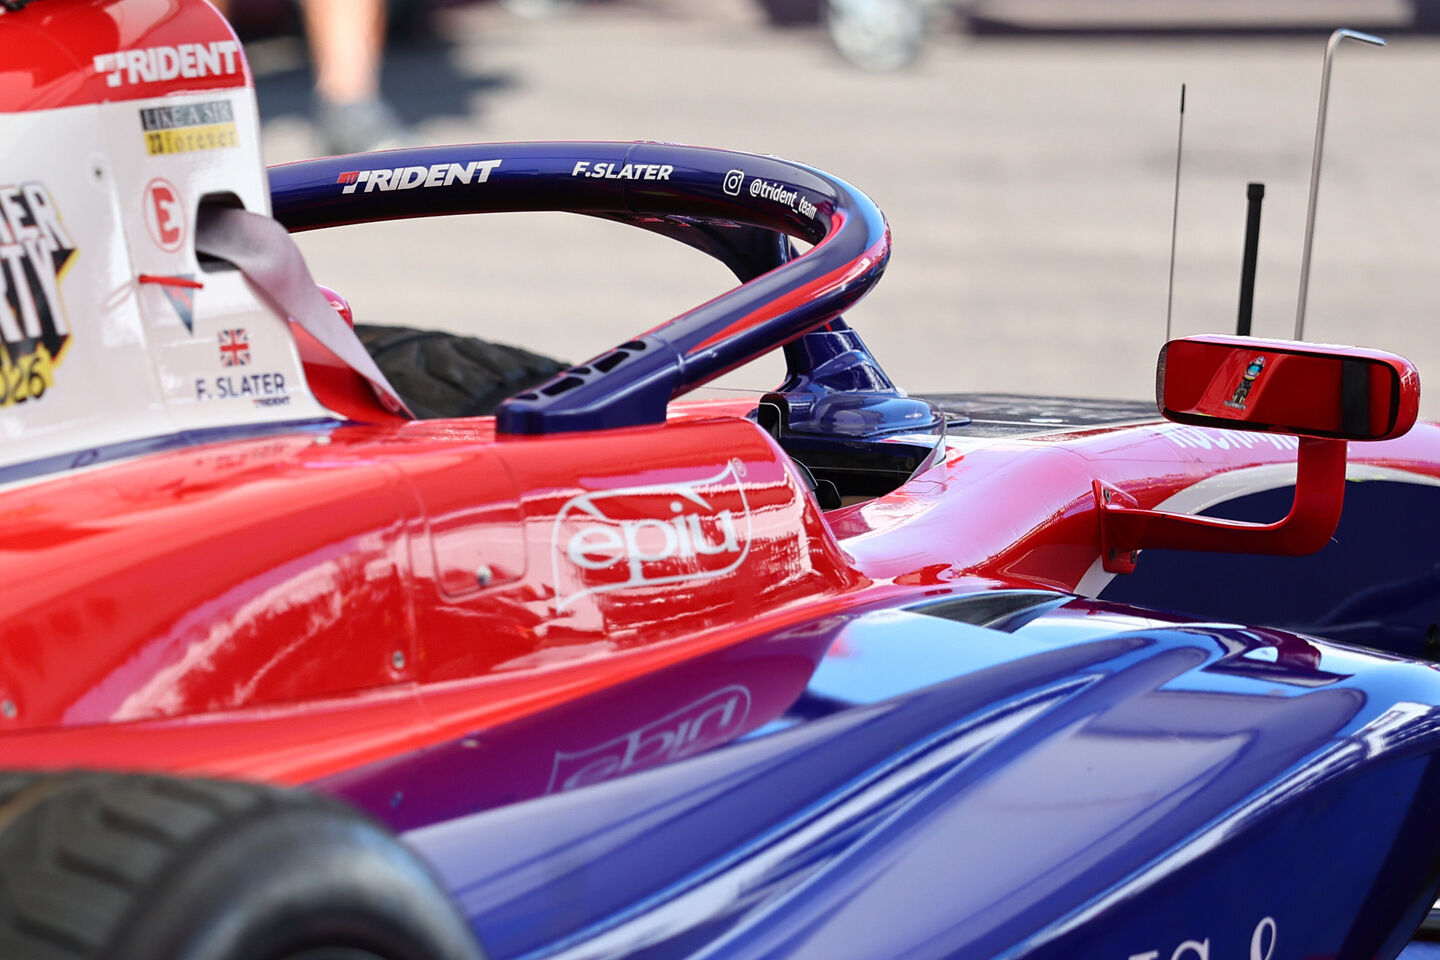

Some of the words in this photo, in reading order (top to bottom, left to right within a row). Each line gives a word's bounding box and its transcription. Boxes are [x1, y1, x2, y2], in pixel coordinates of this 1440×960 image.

[93, 40, 238, 87] TRIDENT
[189, 105, 200, 124] A
[336, 159, 503, 195] TRIDENT
[571, 161, 674, 181] F.SLATER
[152, 187, 180, 244] E
[749, 178, 817, 220] @trident_team
[196, 379, 213, 399] F.
[216, 372, 286, 397] SLATER
